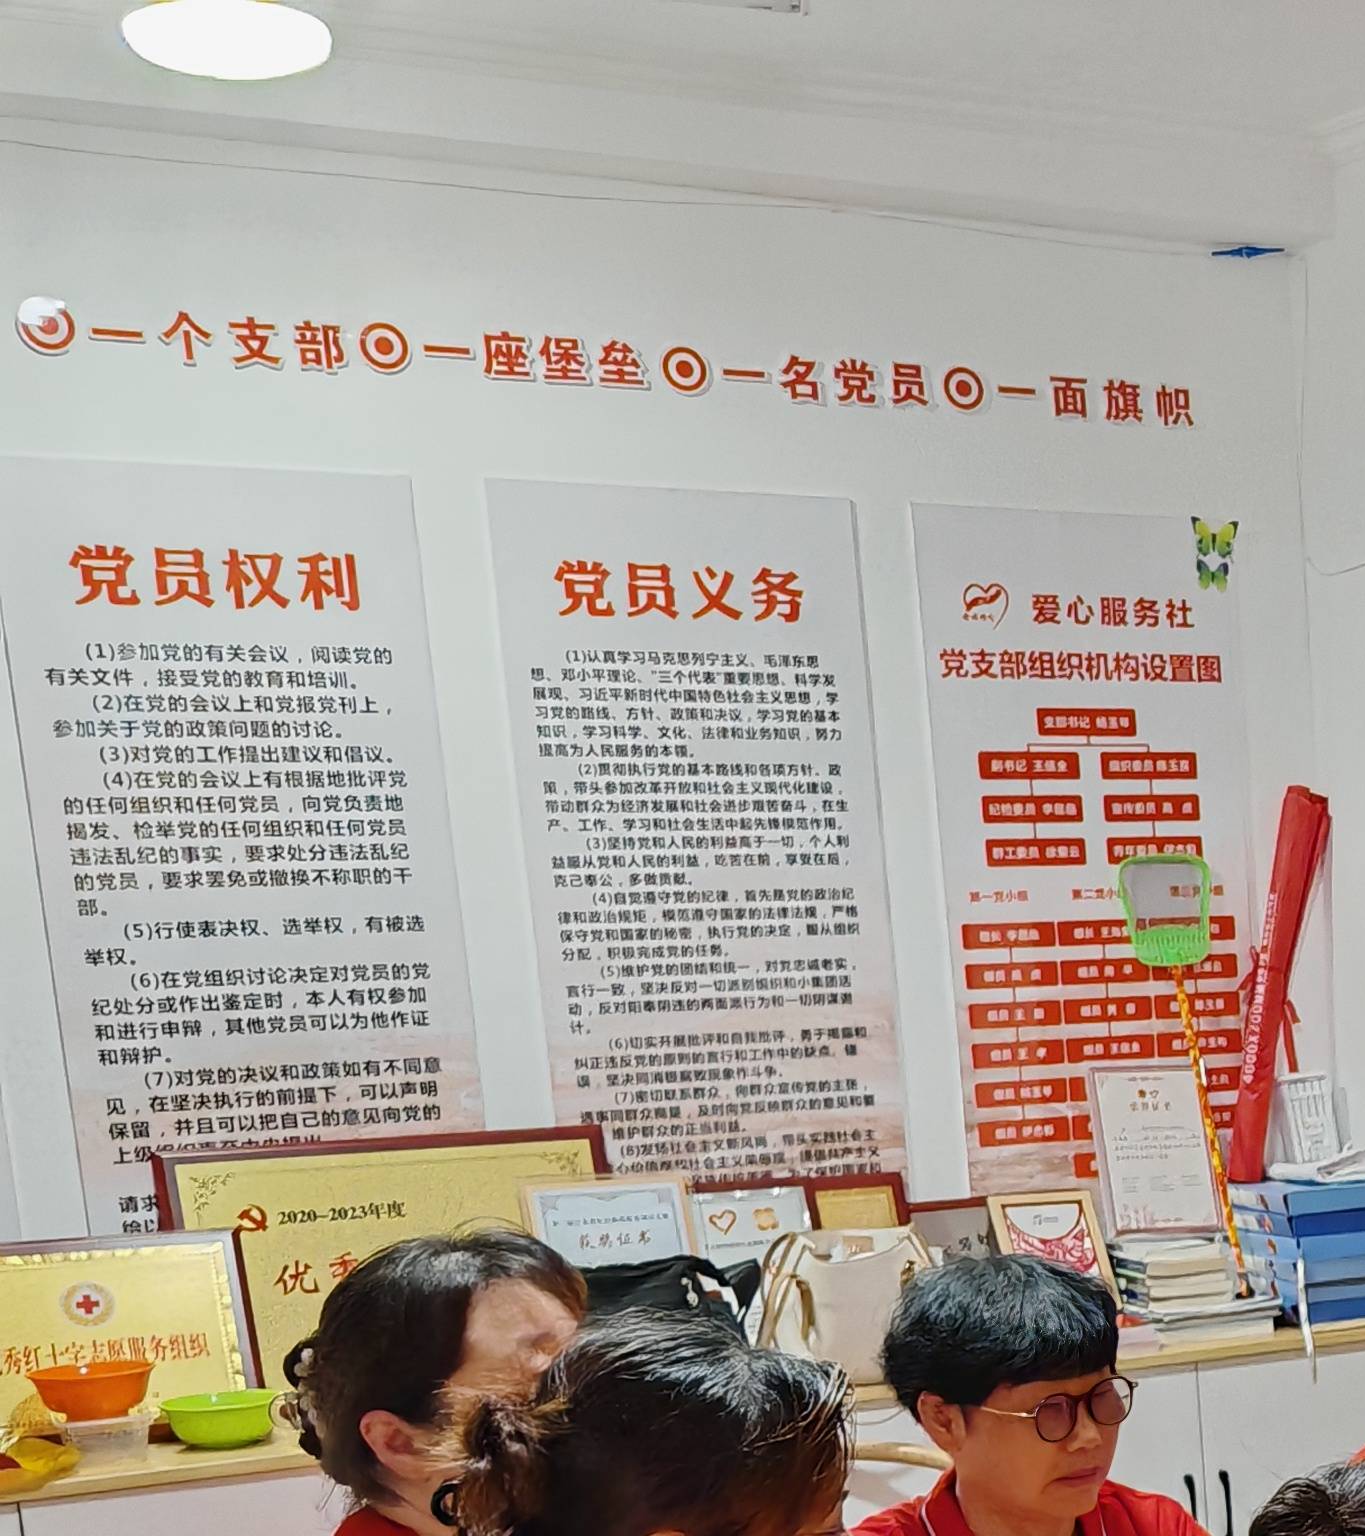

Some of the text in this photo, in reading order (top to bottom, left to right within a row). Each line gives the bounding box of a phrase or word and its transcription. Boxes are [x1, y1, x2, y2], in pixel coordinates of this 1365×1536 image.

[91, 310, 1194, 426] 一个支部 一座堡垒 一名党员 一面旗帜
[68, 545, 361, 611] 党员权利
[553, 558, 804, 622] 党员义务
[1032, 595, 1195, 628] 爱心服务社
[940, 648, 1222, 683] 党支部组织机构设置图
[0, 1333, 210, 1375] 秀红十字志愿服务组织
